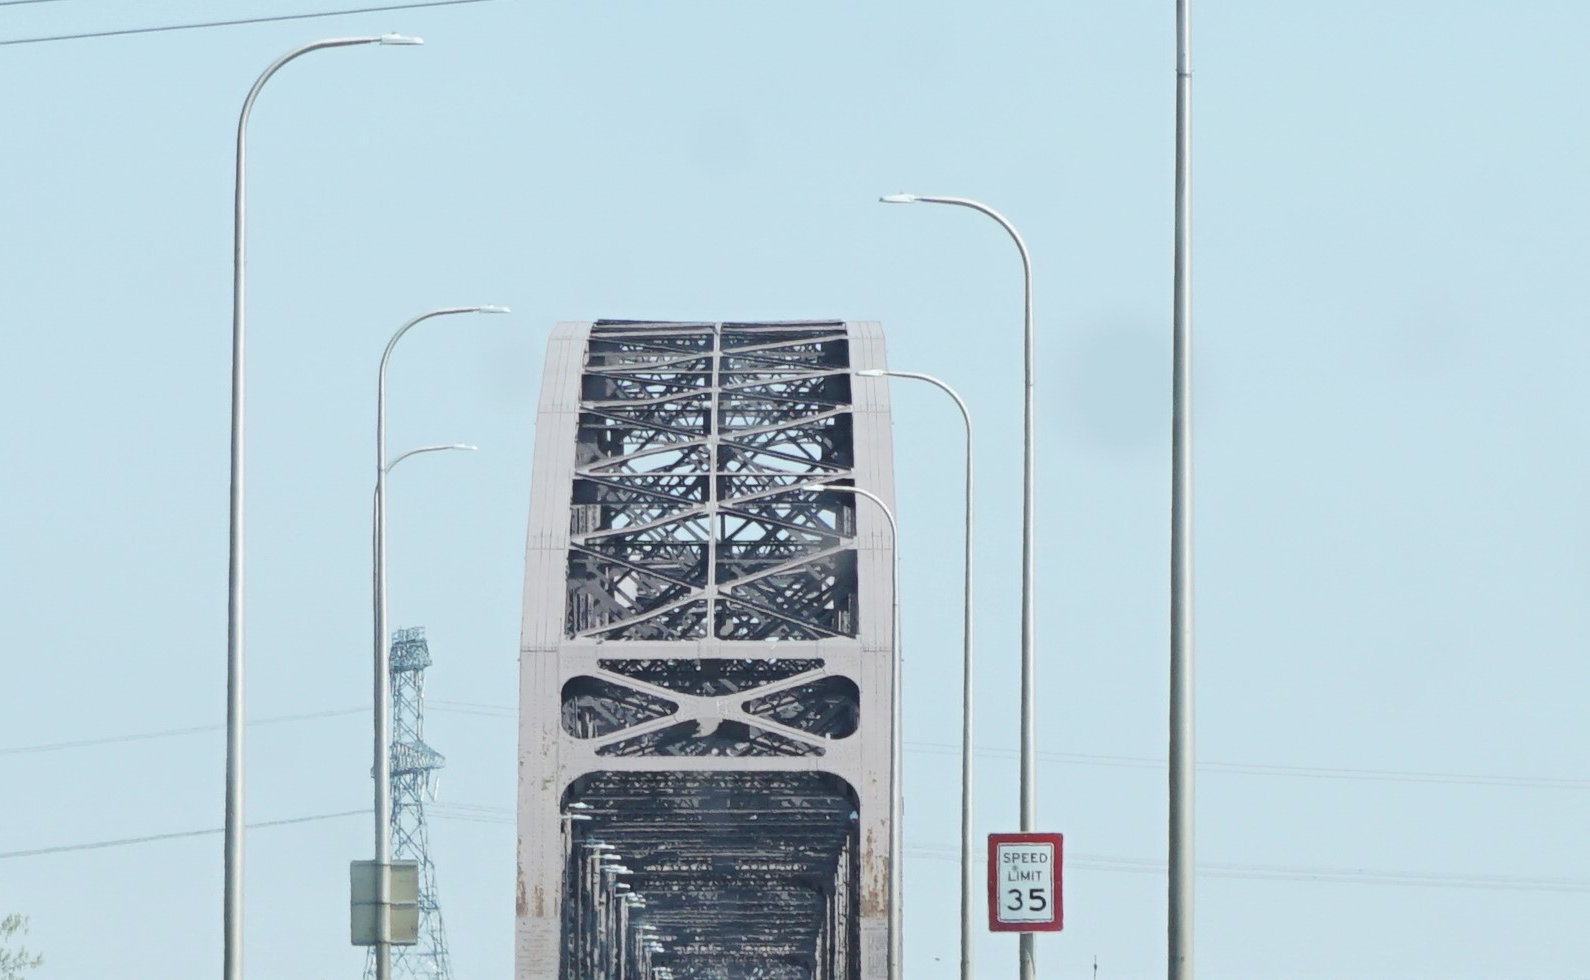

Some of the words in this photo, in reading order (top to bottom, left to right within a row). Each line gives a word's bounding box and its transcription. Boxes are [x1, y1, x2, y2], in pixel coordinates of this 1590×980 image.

[1003, 852, 1048, 864] SPEED
[1007, 870, 1043, 882] LIMIT
[1007, 888, 1047, 912] 35
